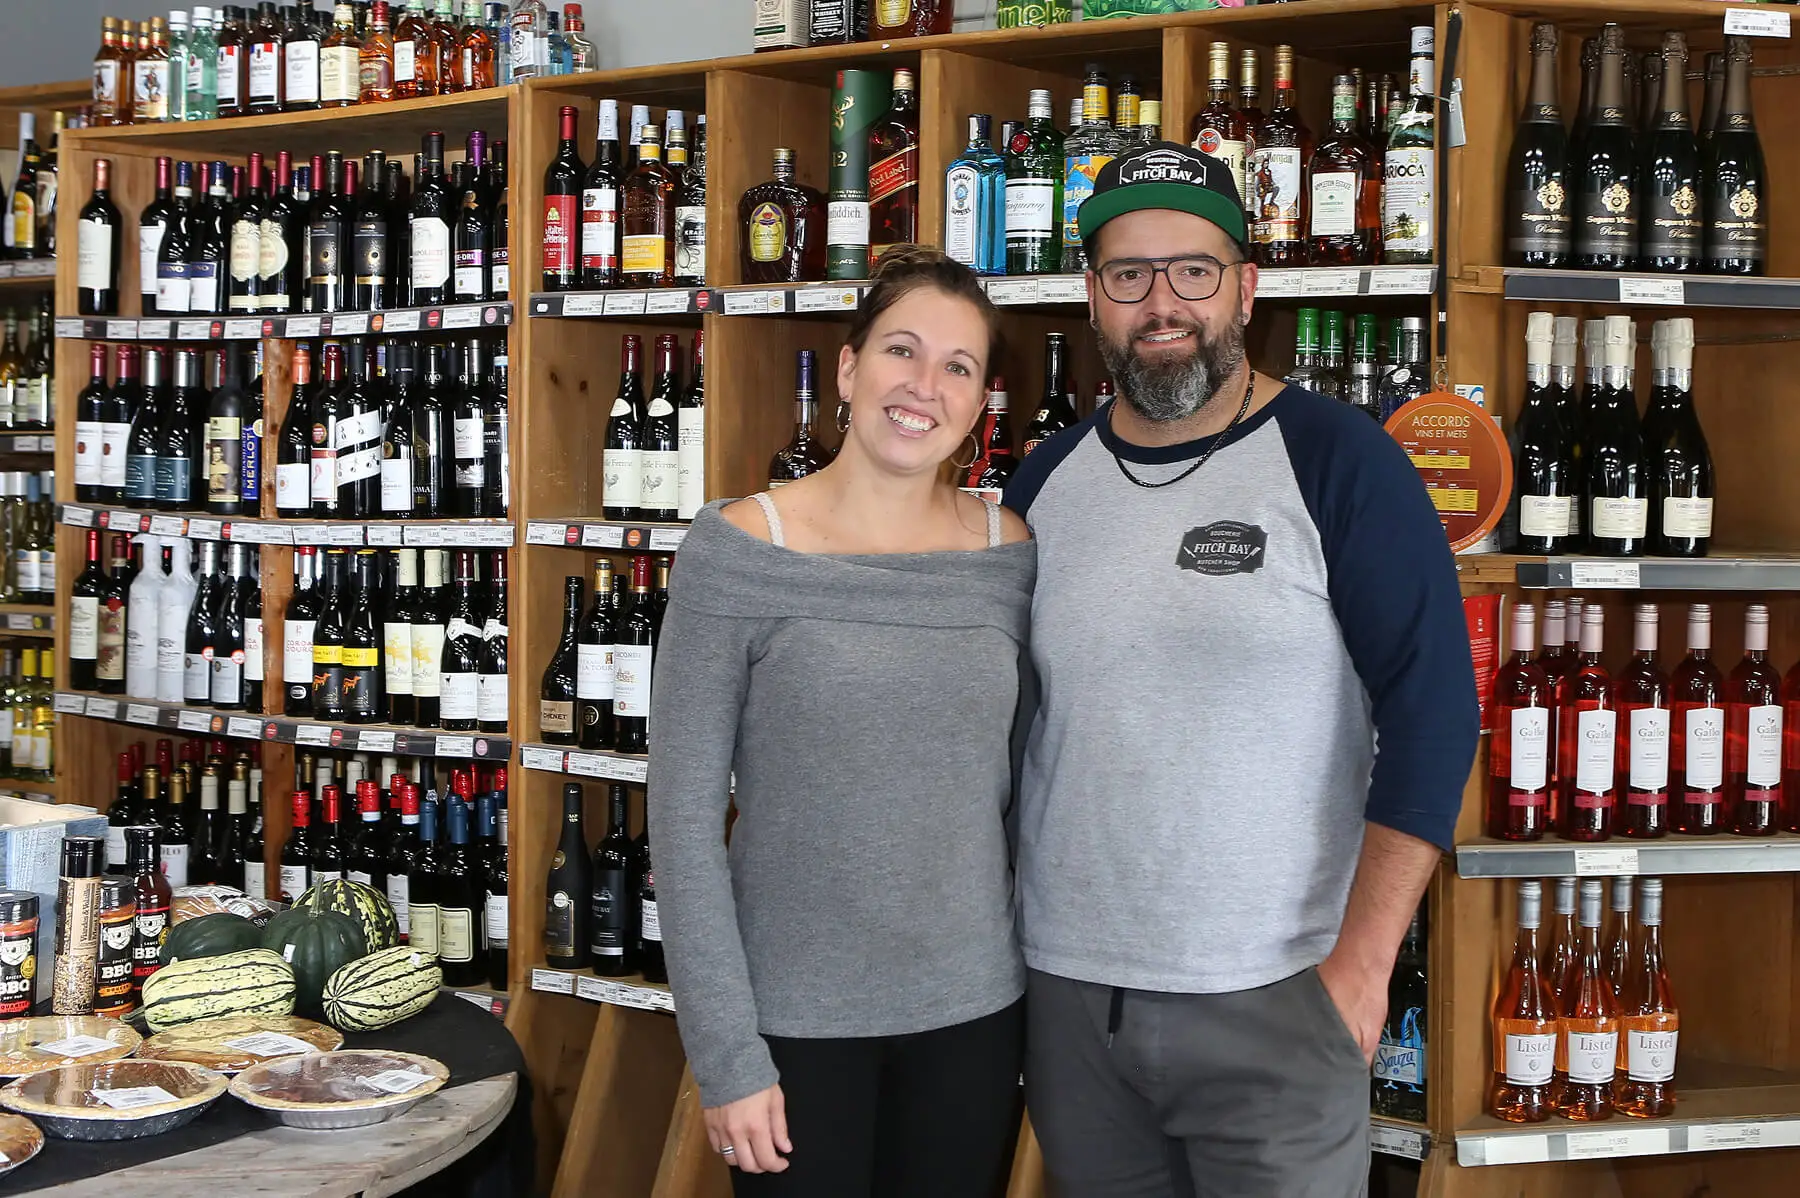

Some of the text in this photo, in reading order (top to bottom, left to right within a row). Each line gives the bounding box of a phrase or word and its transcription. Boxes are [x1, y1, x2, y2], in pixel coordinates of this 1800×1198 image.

[1132, 168, 1193, 181] FITCH BAY
[1411, 415, 1471, 427] ACCORDS
[1414, 429, 1468, 439] VINS ET METS
[246, 432, 256, 489] MERLOT
[1193, 542, 1251, 555] FITCH BAY
[101, 962, 132, 979] BBQ
[1516, 1038, 1551, 1053] Listel
[1580, 1036, 1614, 1051] Listel
[1640, 1034, 1674, 1049] Listel
[1375, 1047, 1415, 1075] Sauza
